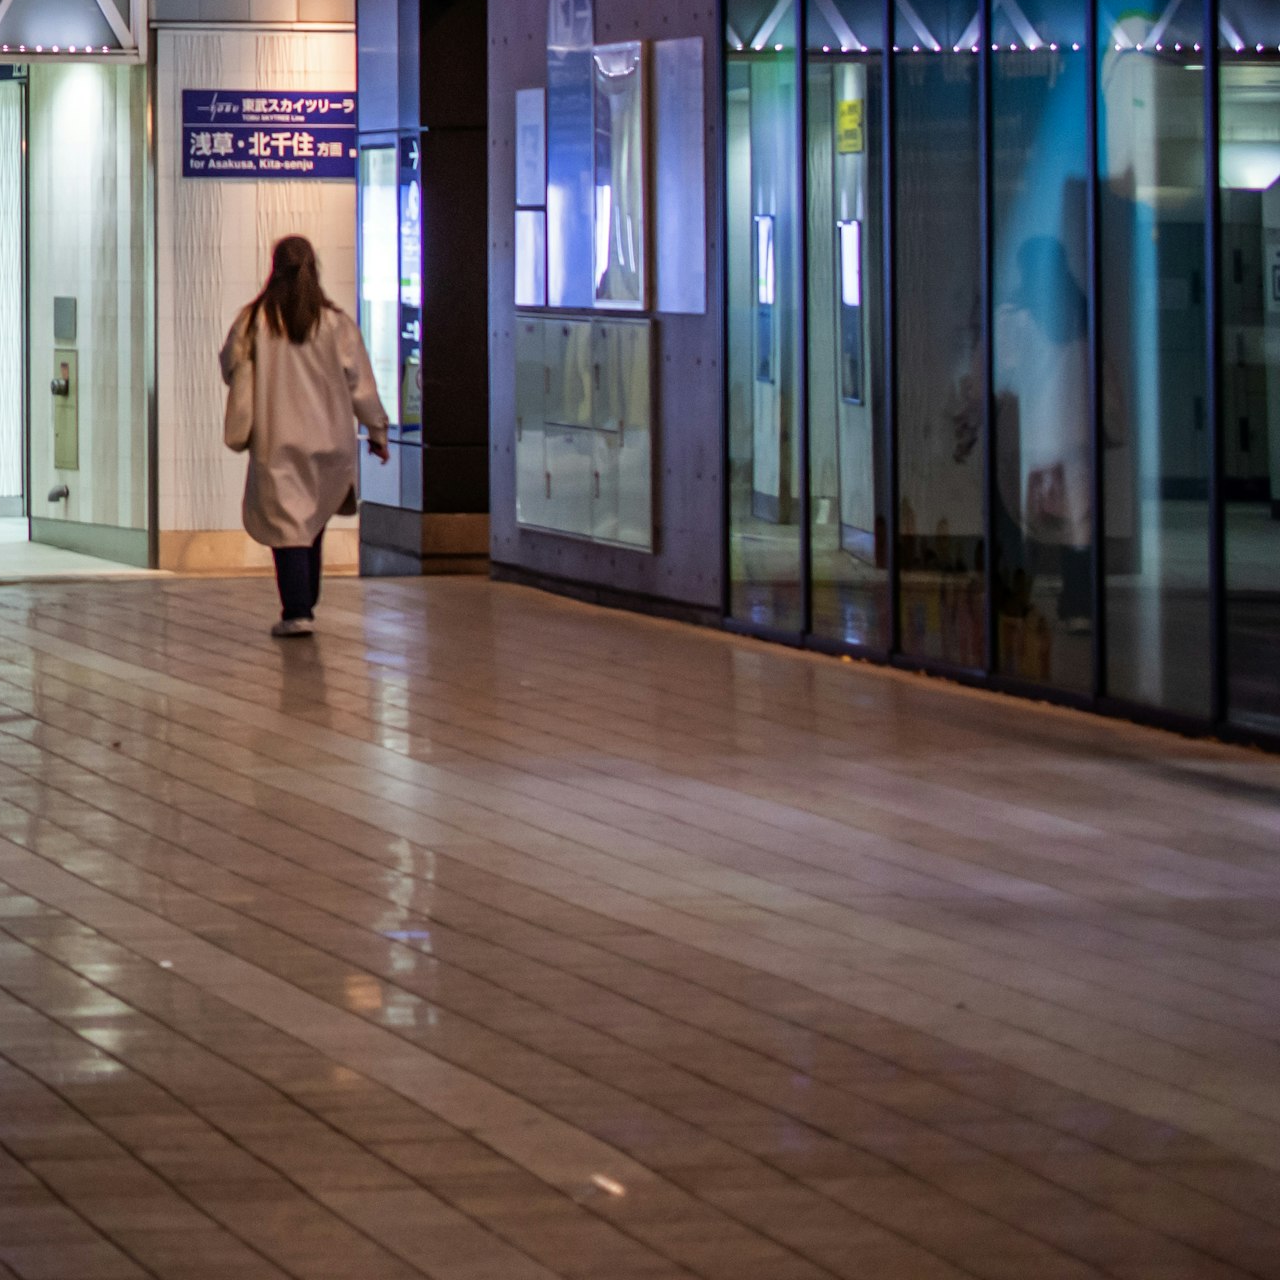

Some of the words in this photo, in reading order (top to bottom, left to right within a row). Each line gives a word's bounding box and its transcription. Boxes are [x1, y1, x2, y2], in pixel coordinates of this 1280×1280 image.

[242, 98, 355, 113] 東武スカイツリーラ
[190, 158, 205, 170] for
[208, 158, 257, 170] Asakusa,
[259, 158, 314, 171] Kita-senju
